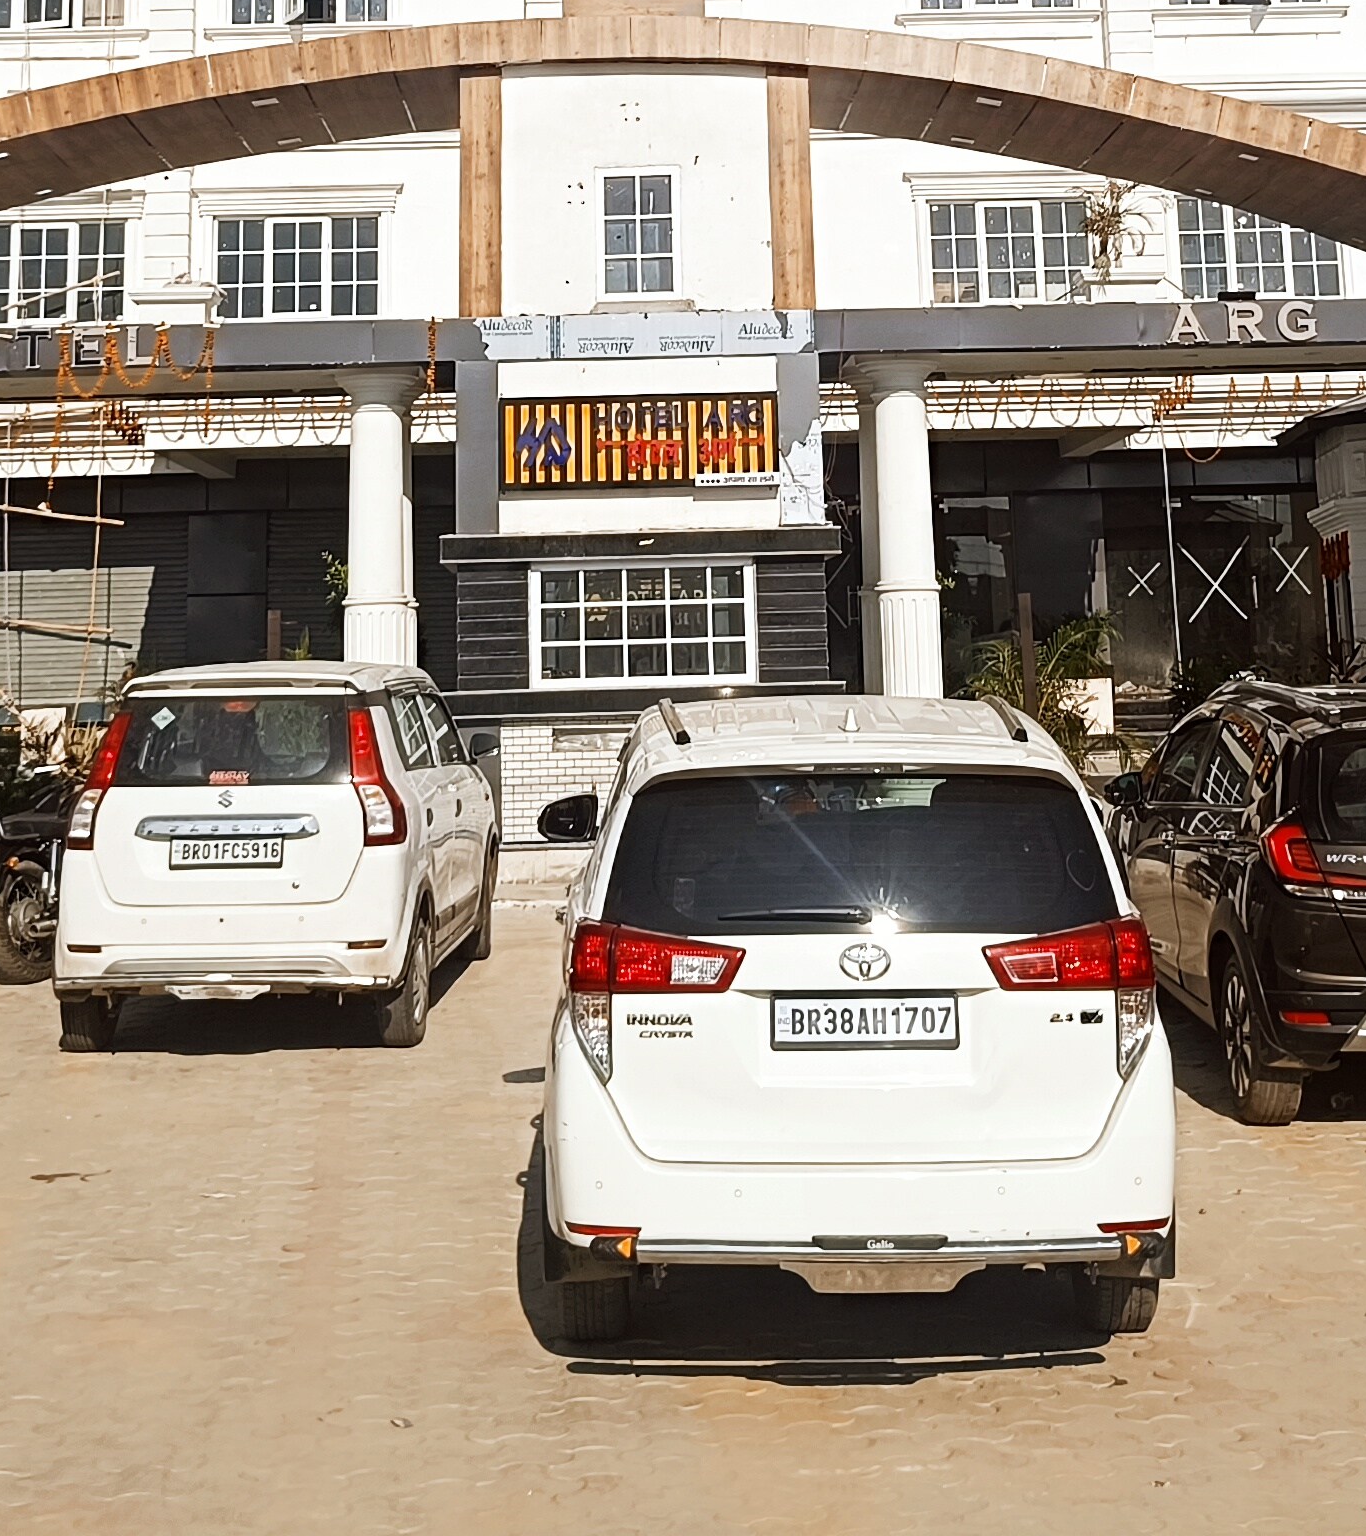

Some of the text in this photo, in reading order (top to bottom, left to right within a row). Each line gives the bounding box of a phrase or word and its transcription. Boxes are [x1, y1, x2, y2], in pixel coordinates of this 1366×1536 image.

[1166, 301, 1318, 343] ARG
[594, 399, 764, 433] HOTEL ARG
[182, 841, 280, 860] BR01FC5916
[626, 1013, 693, 1025] INNOVA
[791, 1006, 952, 1035] BR38AH1707
[639, 1030, 693, 1038] CRYSTA
[866, 1239, 895, 1250] Galio
